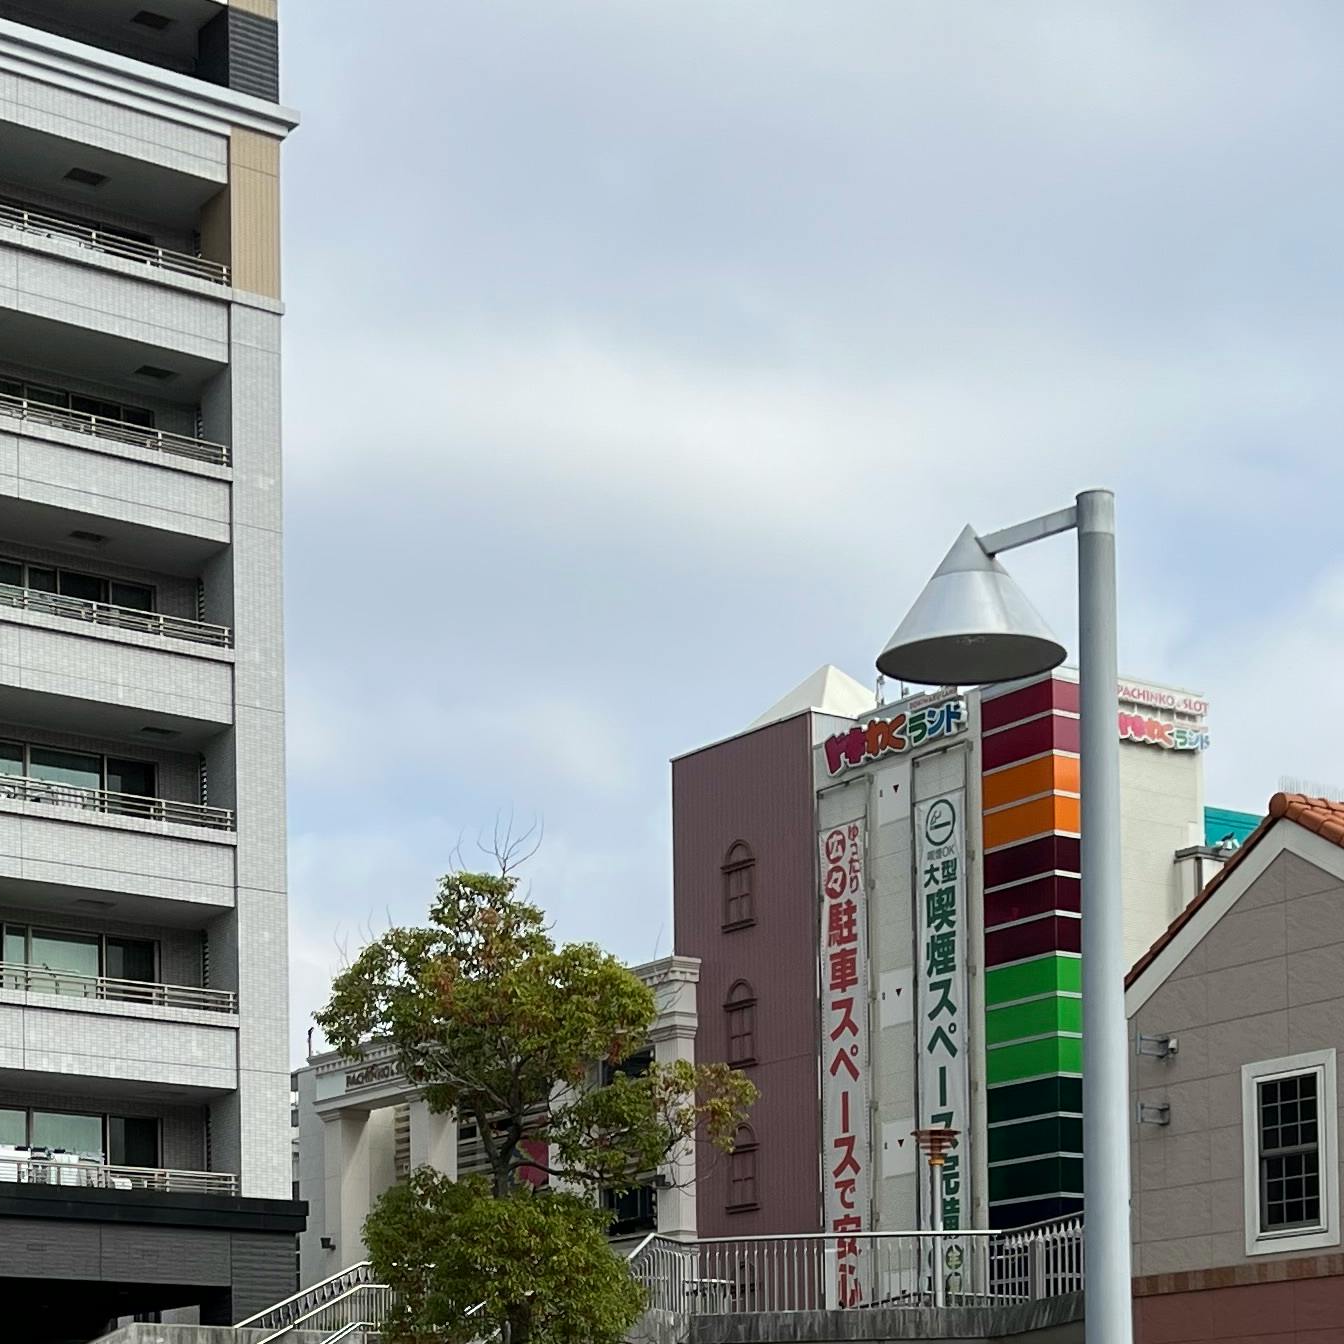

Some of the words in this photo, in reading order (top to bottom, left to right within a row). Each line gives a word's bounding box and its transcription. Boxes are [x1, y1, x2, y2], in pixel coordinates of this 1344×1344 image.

[1117, 685, 1175, 707] PACHINKO
[1183, 697, 1209, 714] SLOT
[847, 824, 861, 895] ゆったり
[824, 828, 862, 1307] 広々駐車スペースで安心
